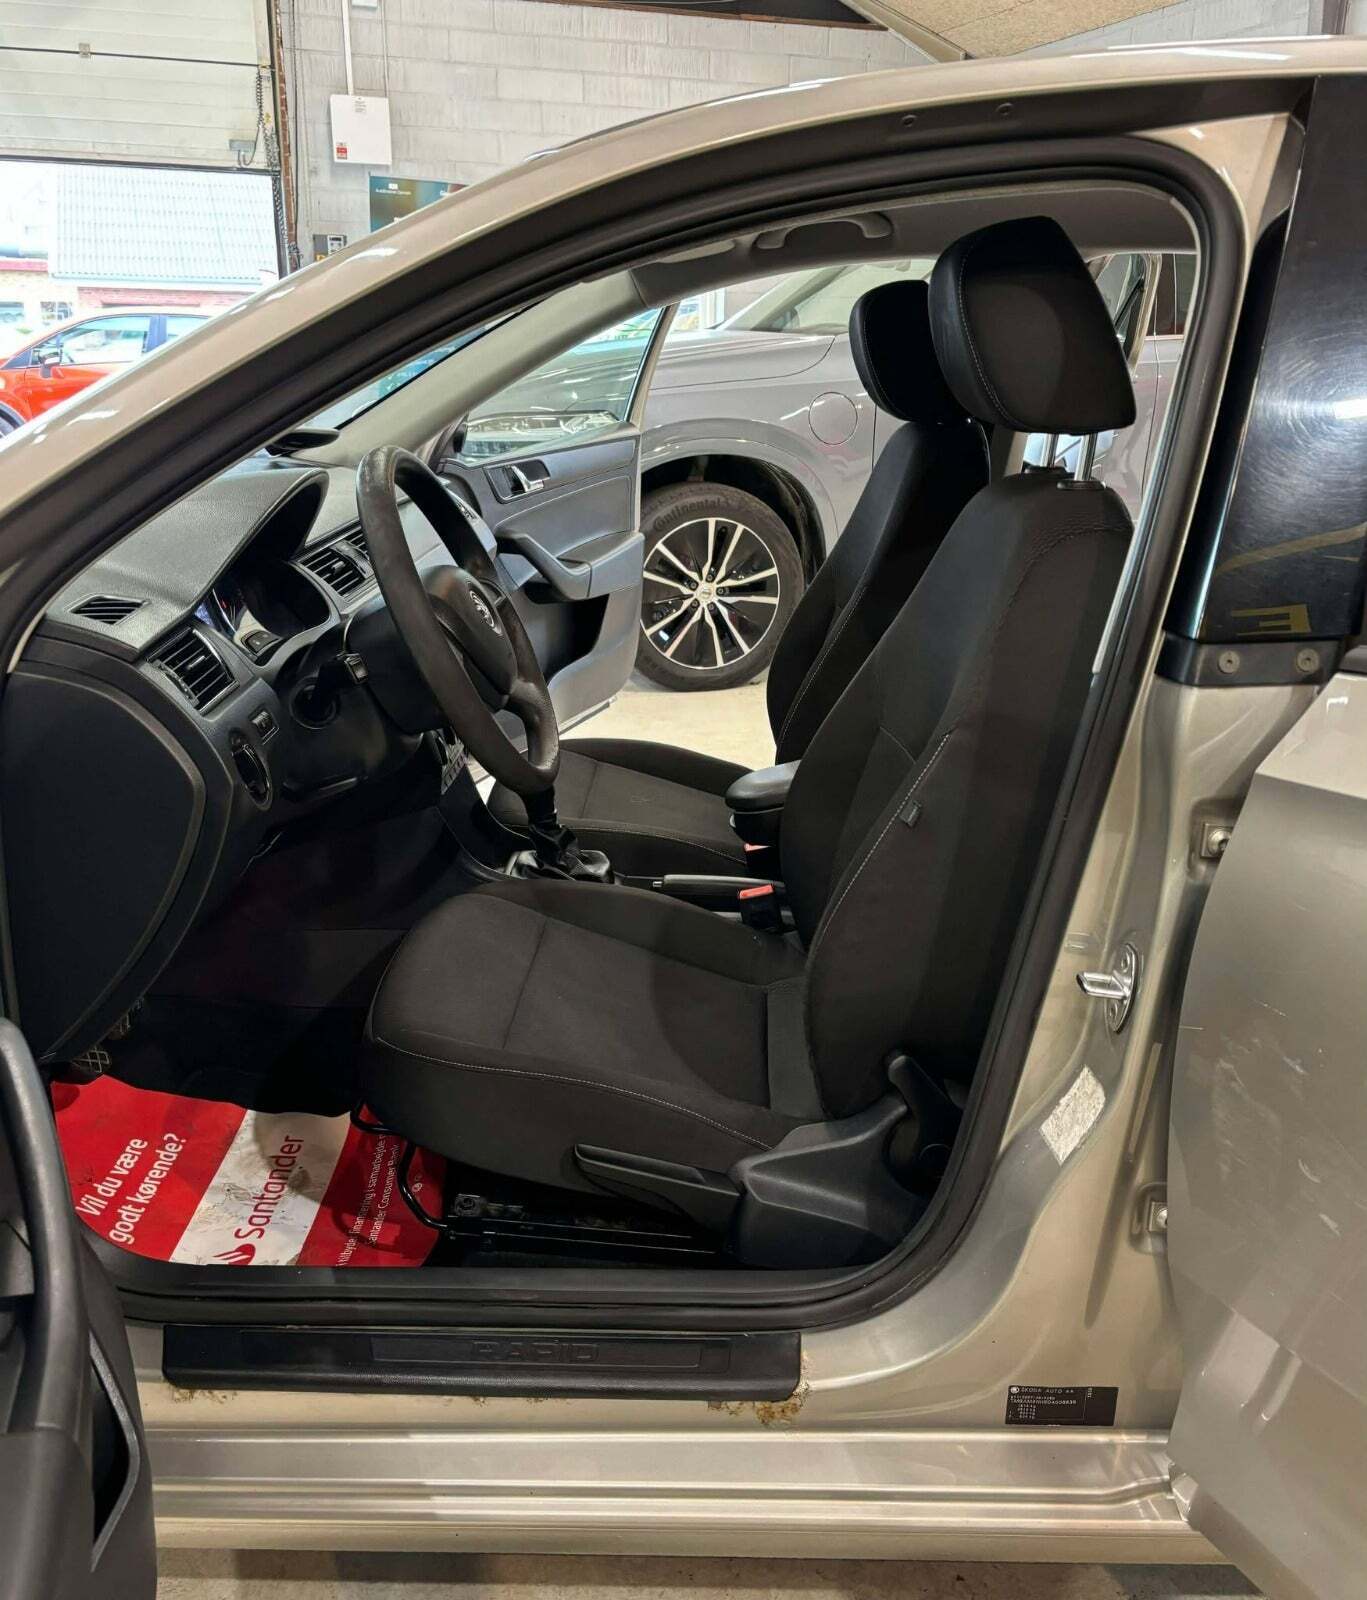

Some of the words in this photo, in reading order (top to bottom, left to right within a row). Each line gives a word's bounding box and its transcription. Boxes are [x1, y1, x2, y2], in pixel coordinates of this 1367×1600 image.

[75, 1194, 108, 1216] Vil
[93, 1177, 123, 1197] du
[109, 1138, 148, 1175] være
[125, 1132, 187, 1204] kørende?
[234, 1135, 305, 1239] Santander
[377, 1167, 396, 1210] Consumer
[109, 1204, 146, 1245] godt
[473, 1341, 599, 1361] RAPID
